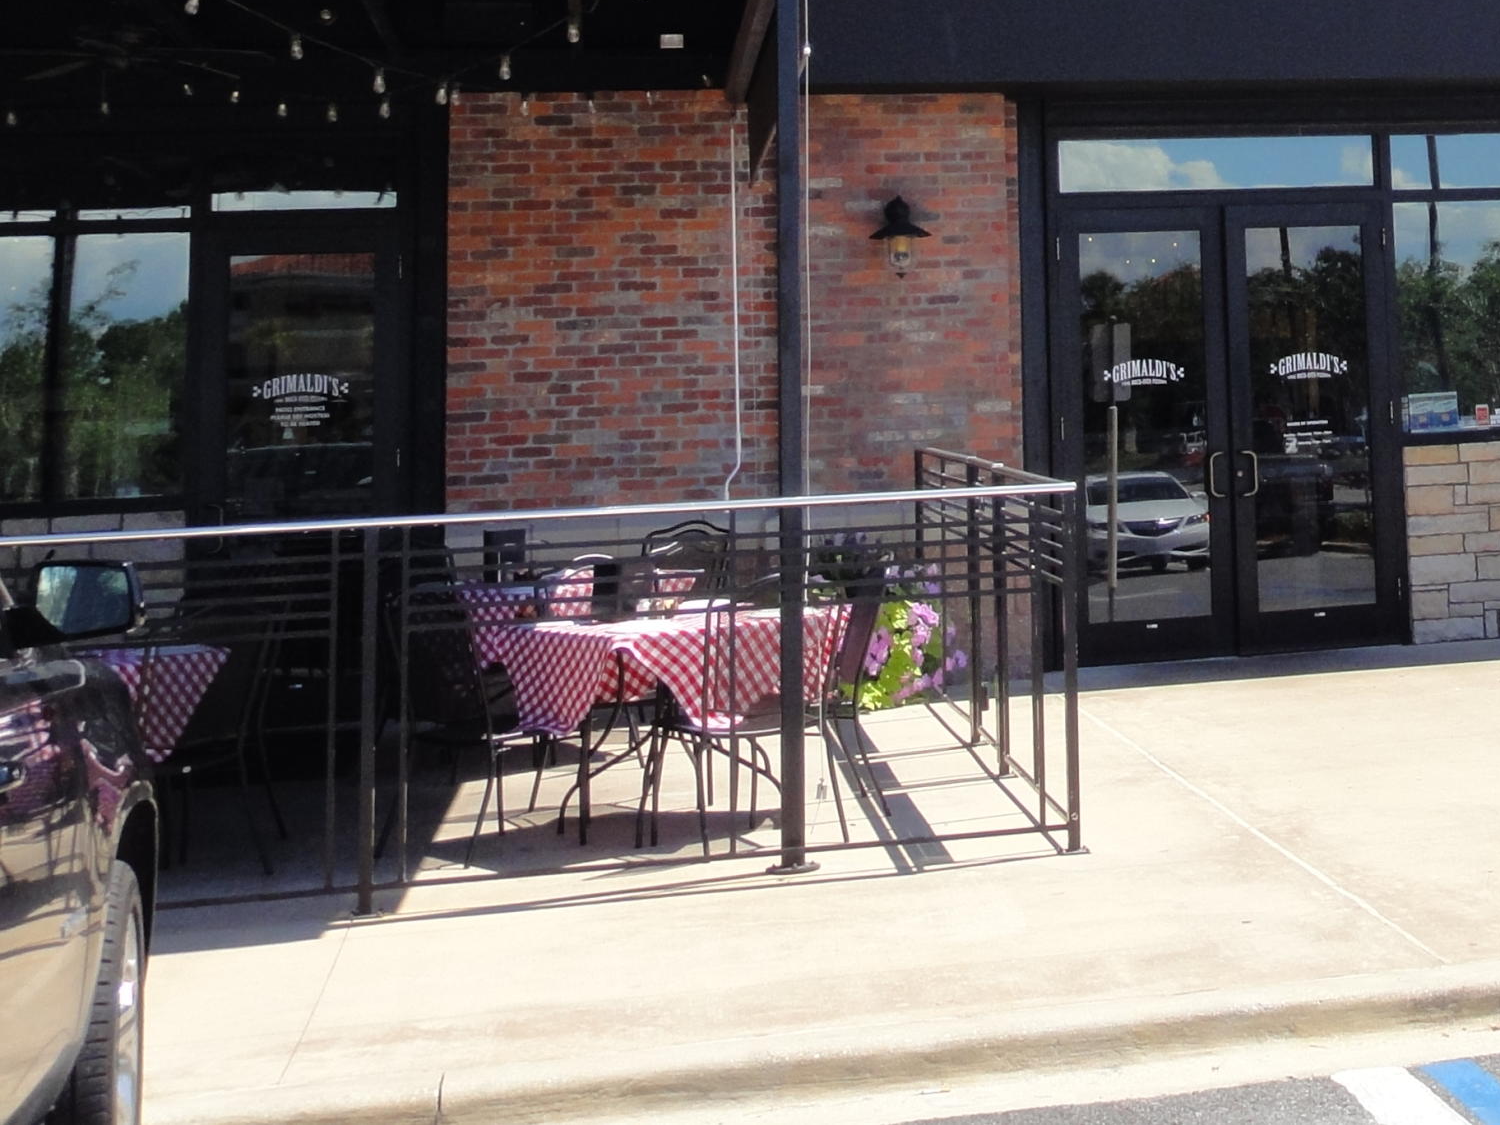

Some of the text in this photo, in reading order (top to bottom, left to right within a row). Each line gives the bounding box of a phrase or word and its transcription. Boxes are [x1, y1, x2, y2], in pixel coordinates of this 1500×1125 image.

[1112, 358, 1179, 383] GRIMALDI'S
[1278, 352, 1342, 376] GRIMALDI'S
[263, 373, 341, 399] GRIMALDI'S
